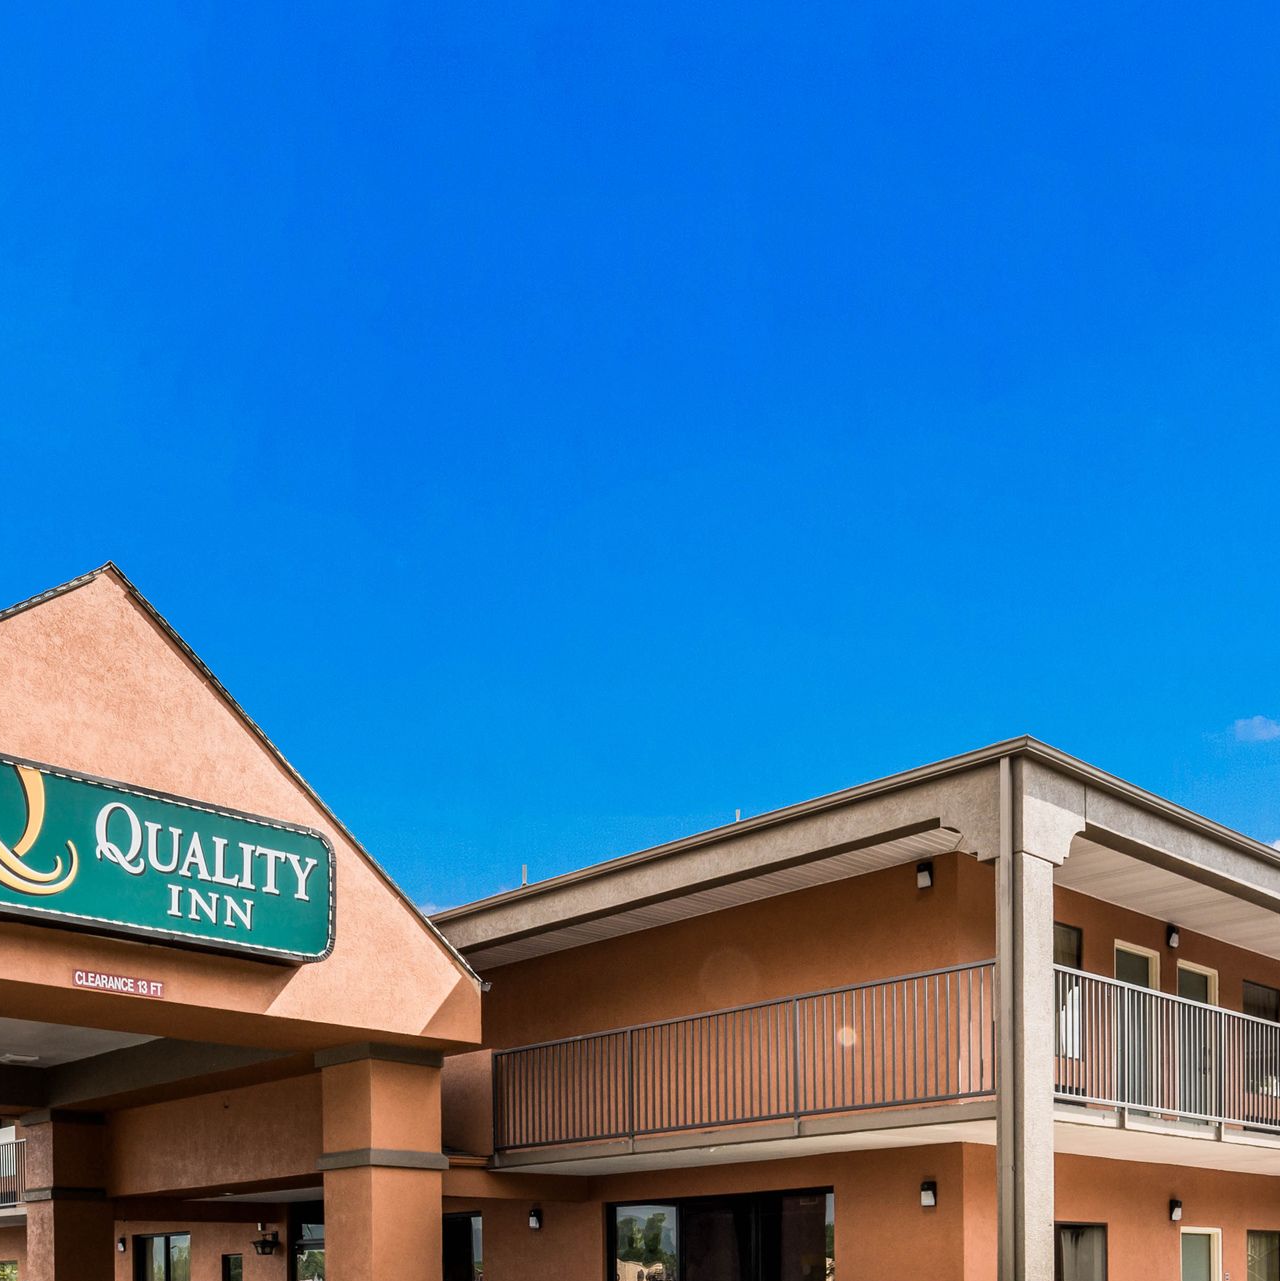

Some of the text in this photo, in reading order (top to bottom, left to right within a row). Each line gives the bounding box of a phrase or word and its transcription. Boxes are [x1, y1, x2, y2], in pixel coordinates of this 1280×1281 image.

[96, 802, 318, 901] QUALITY
[167, 884, 254, 931] INN
[75, 971, 163, 996] CLEARANCE 13 FT
